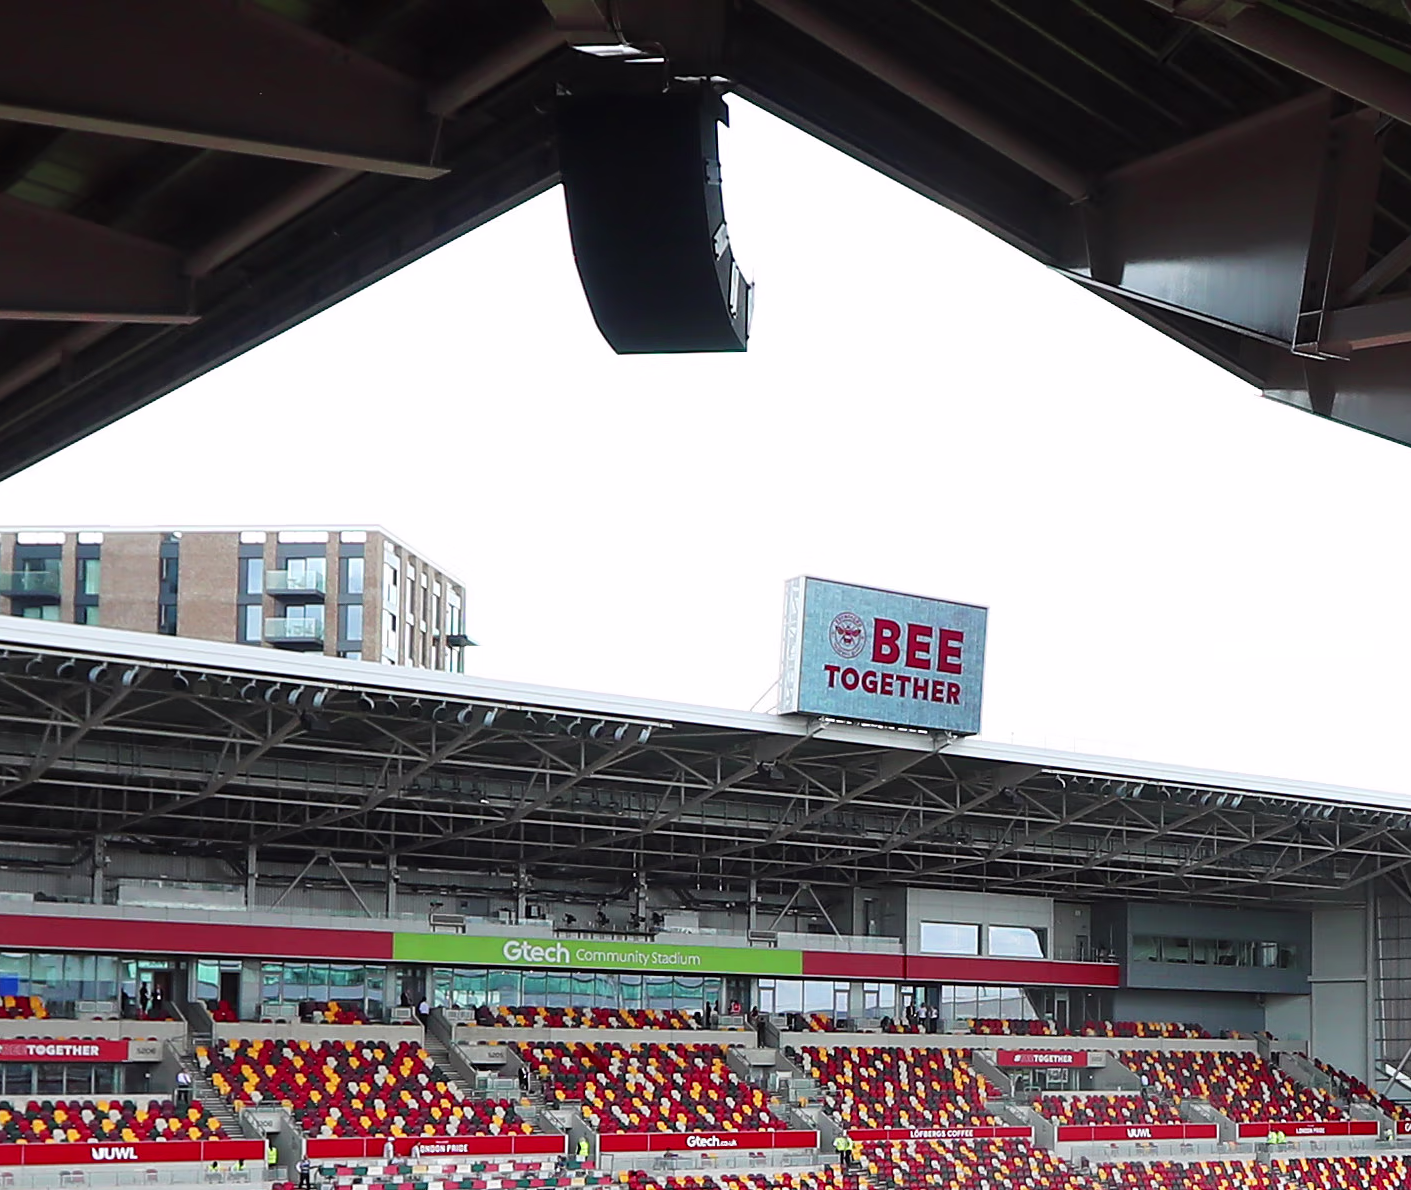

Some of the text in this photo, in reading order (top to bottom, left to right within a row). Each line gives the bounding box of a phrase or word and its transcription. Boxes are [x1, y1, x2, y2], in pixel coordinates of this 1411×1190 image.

[871, 617, 964, 675] BEE
[824, 664, 961, 704] TOGETHER
[503, 940, 700, 966] Gtech Community Stadium
